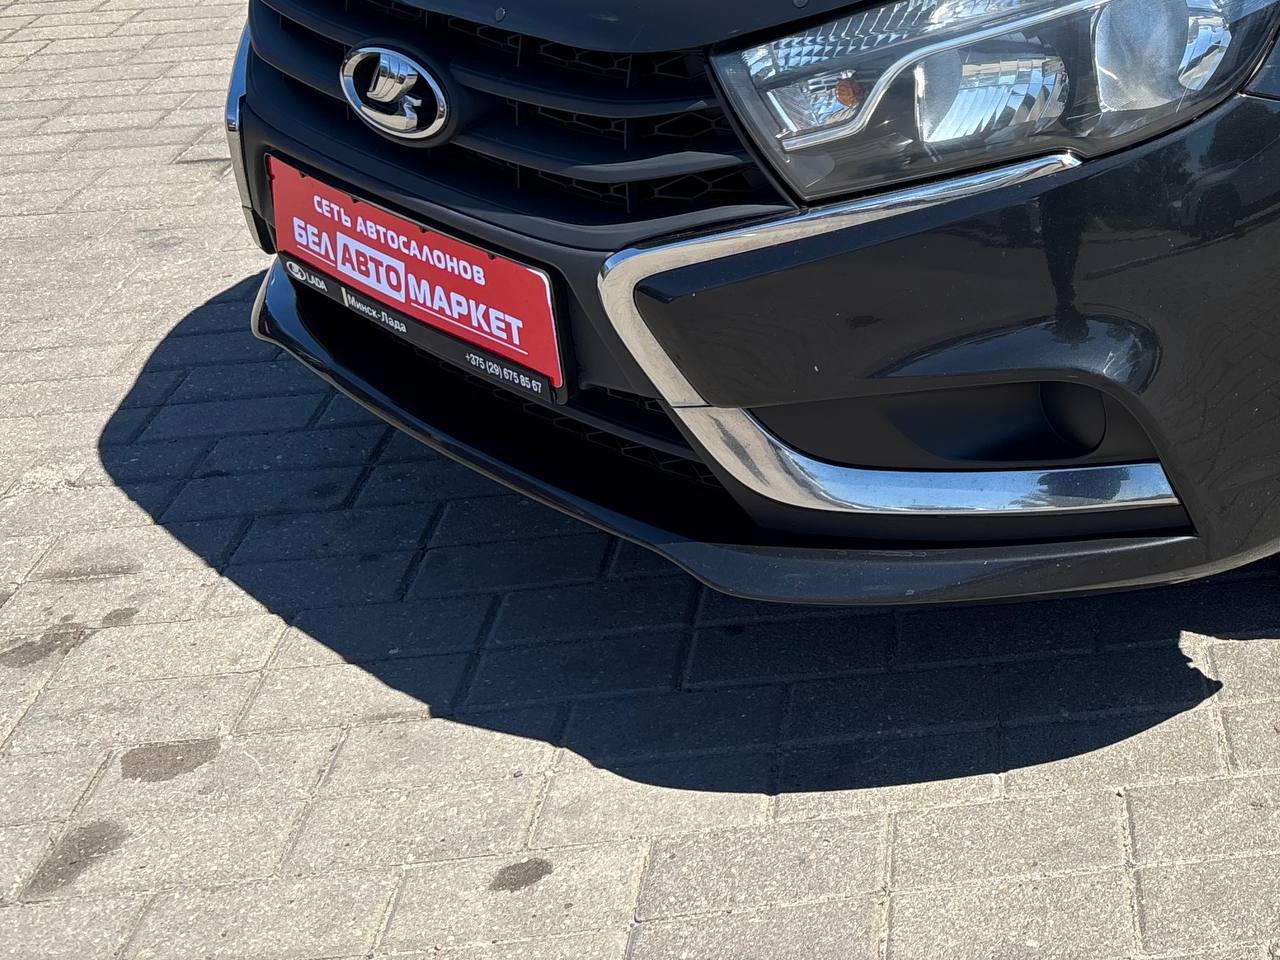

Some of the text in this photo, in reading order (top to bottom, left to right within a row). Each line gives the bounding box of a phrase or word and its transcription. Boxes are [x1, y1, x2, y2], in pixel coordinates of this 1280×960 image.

[313, 194, 486, 286] СЕТЬ АВТОСАЛОНОВ
[305, 271, 328, 292] LADA
[347, 295, 407, 333] Минск-Лада
[465, 352, 542, 393] +375 (29) 675 85 67
